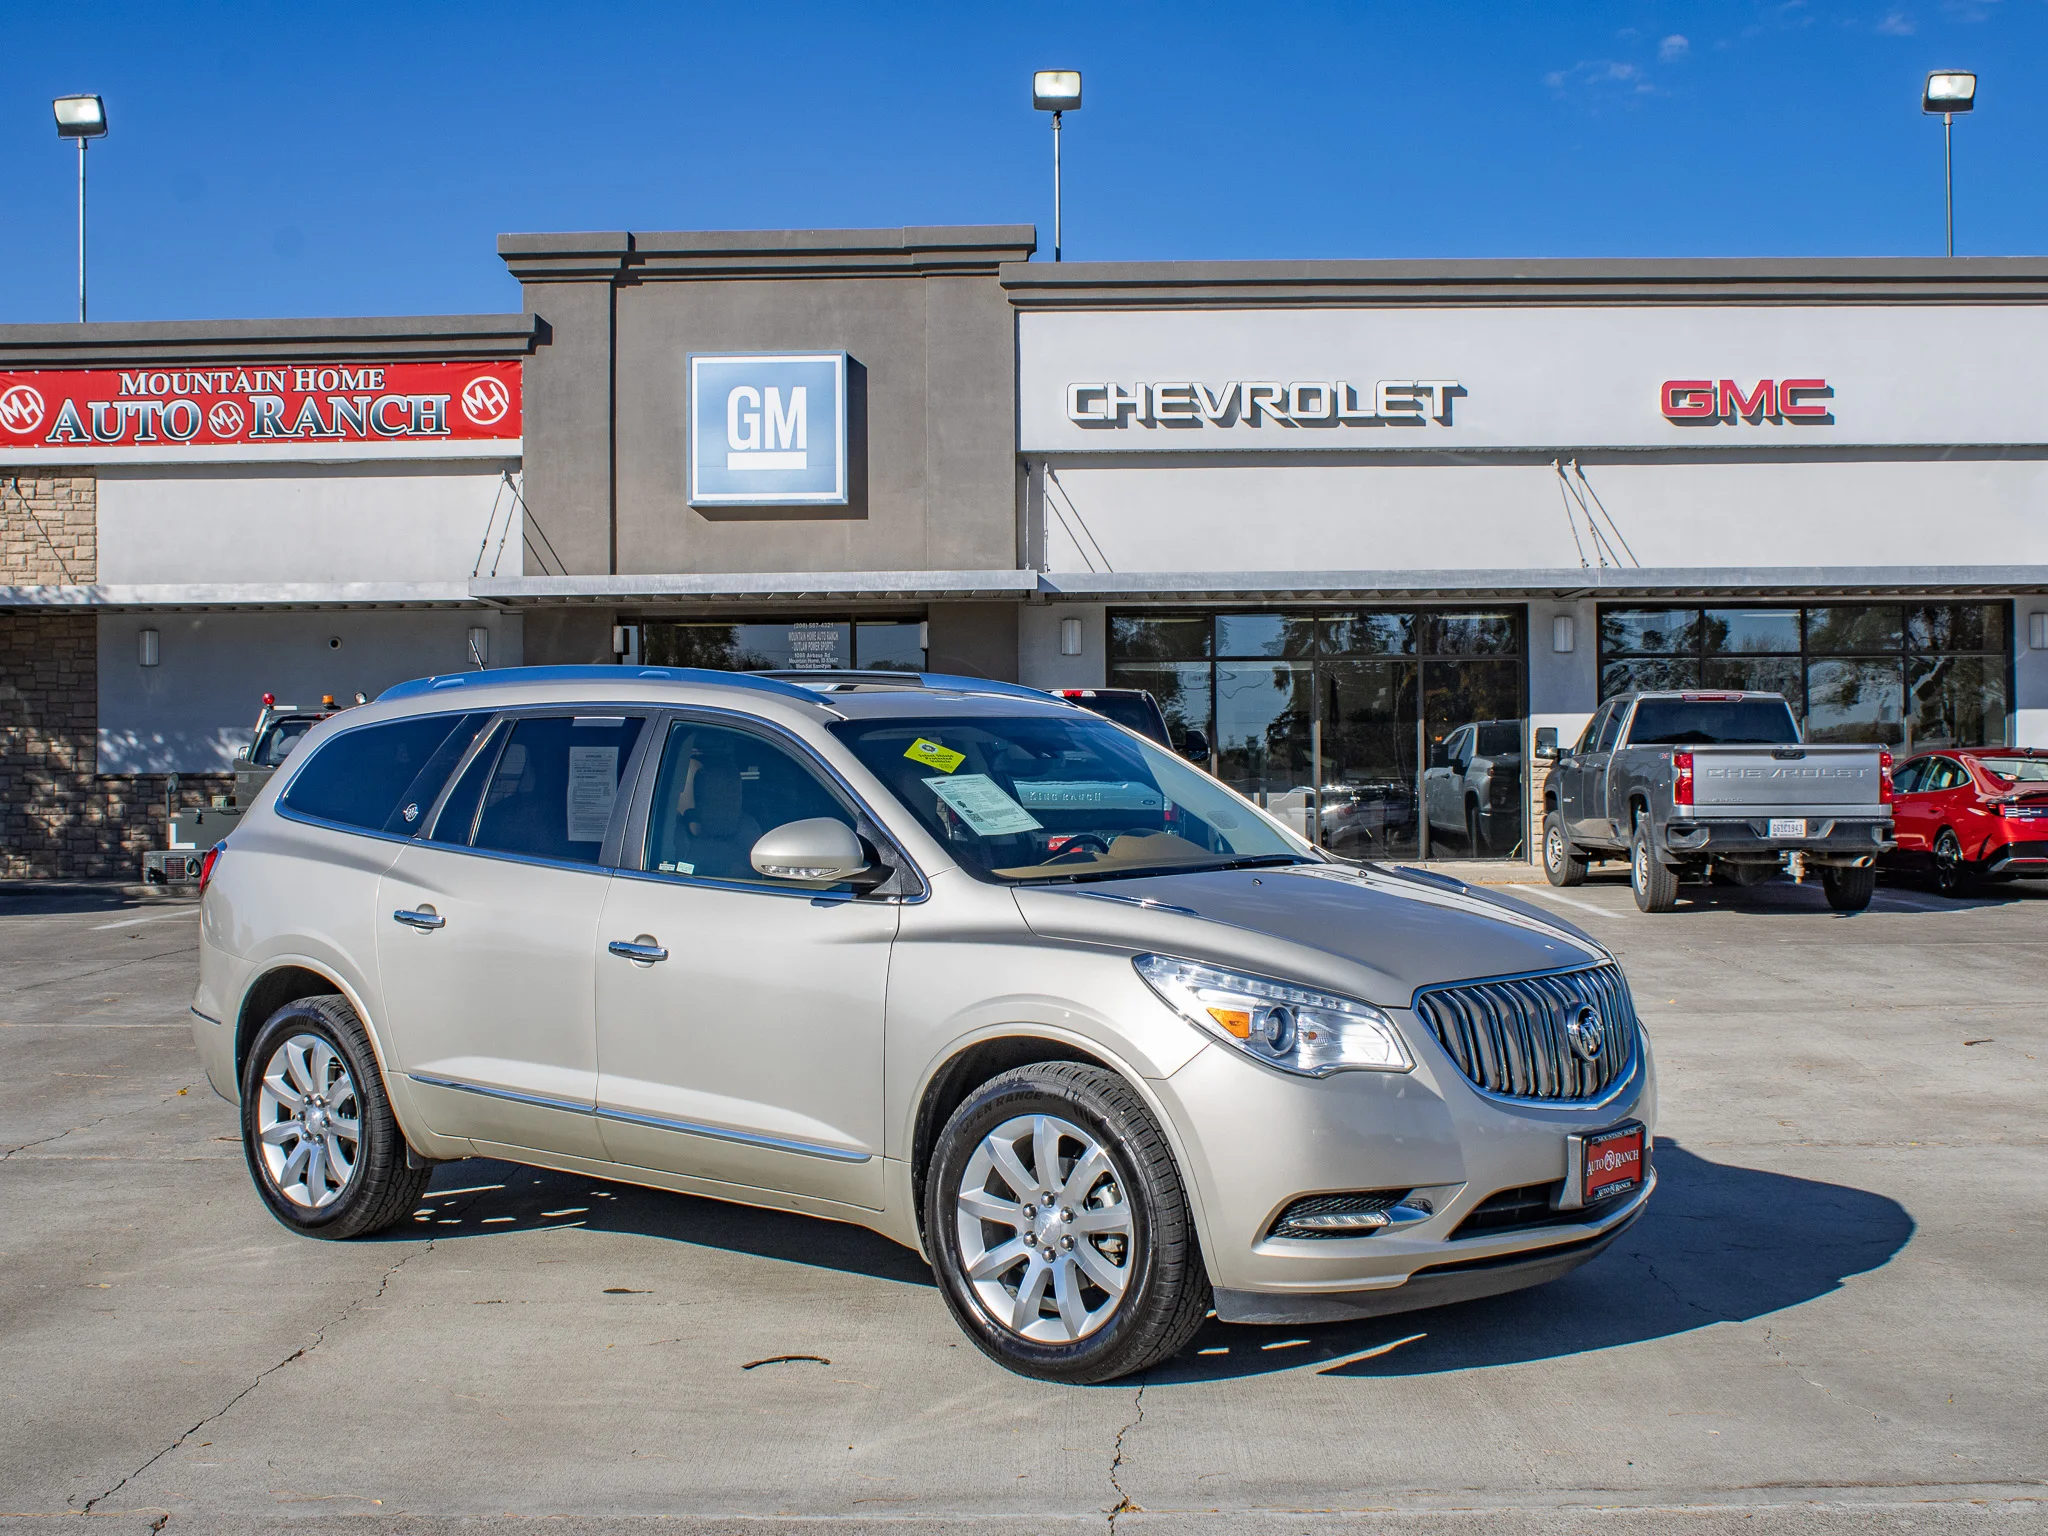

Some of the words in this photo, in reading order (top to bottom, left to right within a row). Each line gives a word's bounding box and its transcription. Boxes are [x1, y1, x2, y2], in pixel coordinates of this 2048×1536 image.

[118, 370, 287, 396] MOUNTAIN
[292, 368, 386, 392] HOME
[1066, 379, 1460, 422] CHEVROLET
[1660, 378, 1828, 417] GMC
[45, 398, 202, 442] AUTO
[248, 394, 451, 438] RANCH
[727, 386, 807, 450] GM
[788, 631, 807, 641] MOUNTAIN
[807, 631, 817, 641] HOME
[817, 631, 826, 641] AUTO
[826, 631, 839, 641] RANCH
[808, 641, 820, 651] POWER
[1706, 768, 1870, 779] CHEVROLET
[1029, 791, 1058, 801] KING
[1062, 792, 1101, 801] RANCH
[996, 1090, 1044, 1107] RANGE
[1586, 1158, 1604, 1177] AUTO
[1615, 1149, 1639, 1168] RANCH
[1615, 1180, 1631, 1192] RANCH
